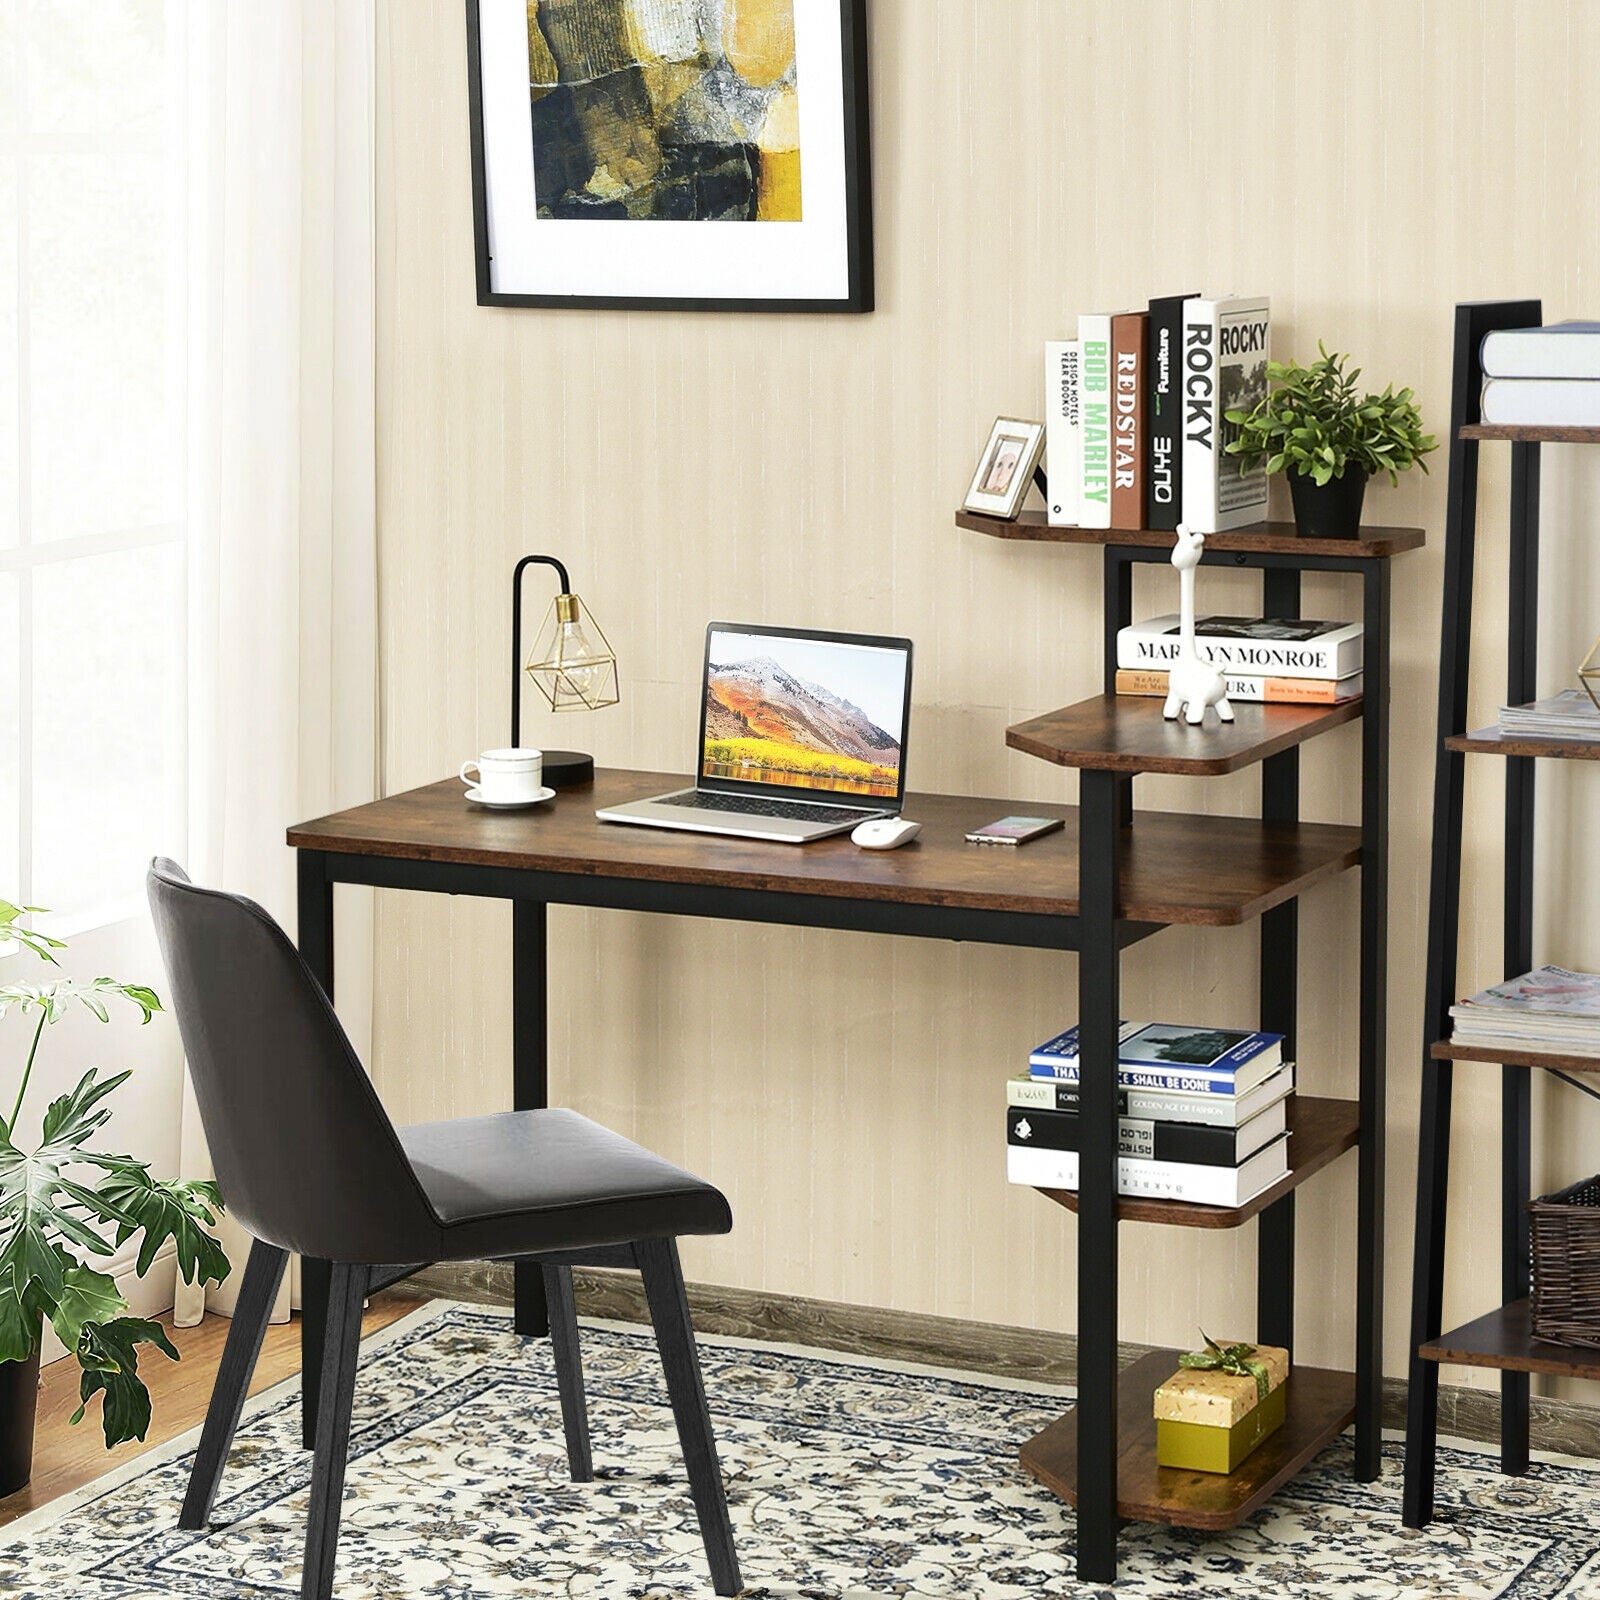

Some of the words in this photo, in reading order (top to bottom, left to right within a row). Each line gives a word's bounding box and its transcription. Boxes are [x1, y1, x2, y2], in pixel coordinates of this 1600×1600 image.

[1220, 322, 1268, 356] ROCKY
[1061, 351, 1069, 376] YEAR
[1069, 351, 1078, 386] DESIGN
[1084, 341, 1107, 391] BOB
[1157, 328, 1169, 394] Furniture
[1186, 323, 1213, 450] ROCKY
[1070, 389, 1079, 426] HOTELS
[1115, 352, 1136, 489] REDSTAR
[1084, 403, 1108, 503] MARLEY
[1153, 436, 1172, 503] OUYE
[1137, 642, 1232, 662] MARYN
[1238, 647, 1328, 669] MONROE
[1133, 1073, 1164, 1088] SHALL
[1166, 1076, 1180, 1089] BE
[1181, 1078, 1211, 1092] DONE
[1162, 1102, 1178, 1112] AGE
[1180, 1104, 1190, 1112] OF
[1119, 1142, 1152, 1155] ASTRO
[1120, 1128, 1152, 1140] IGLOO
